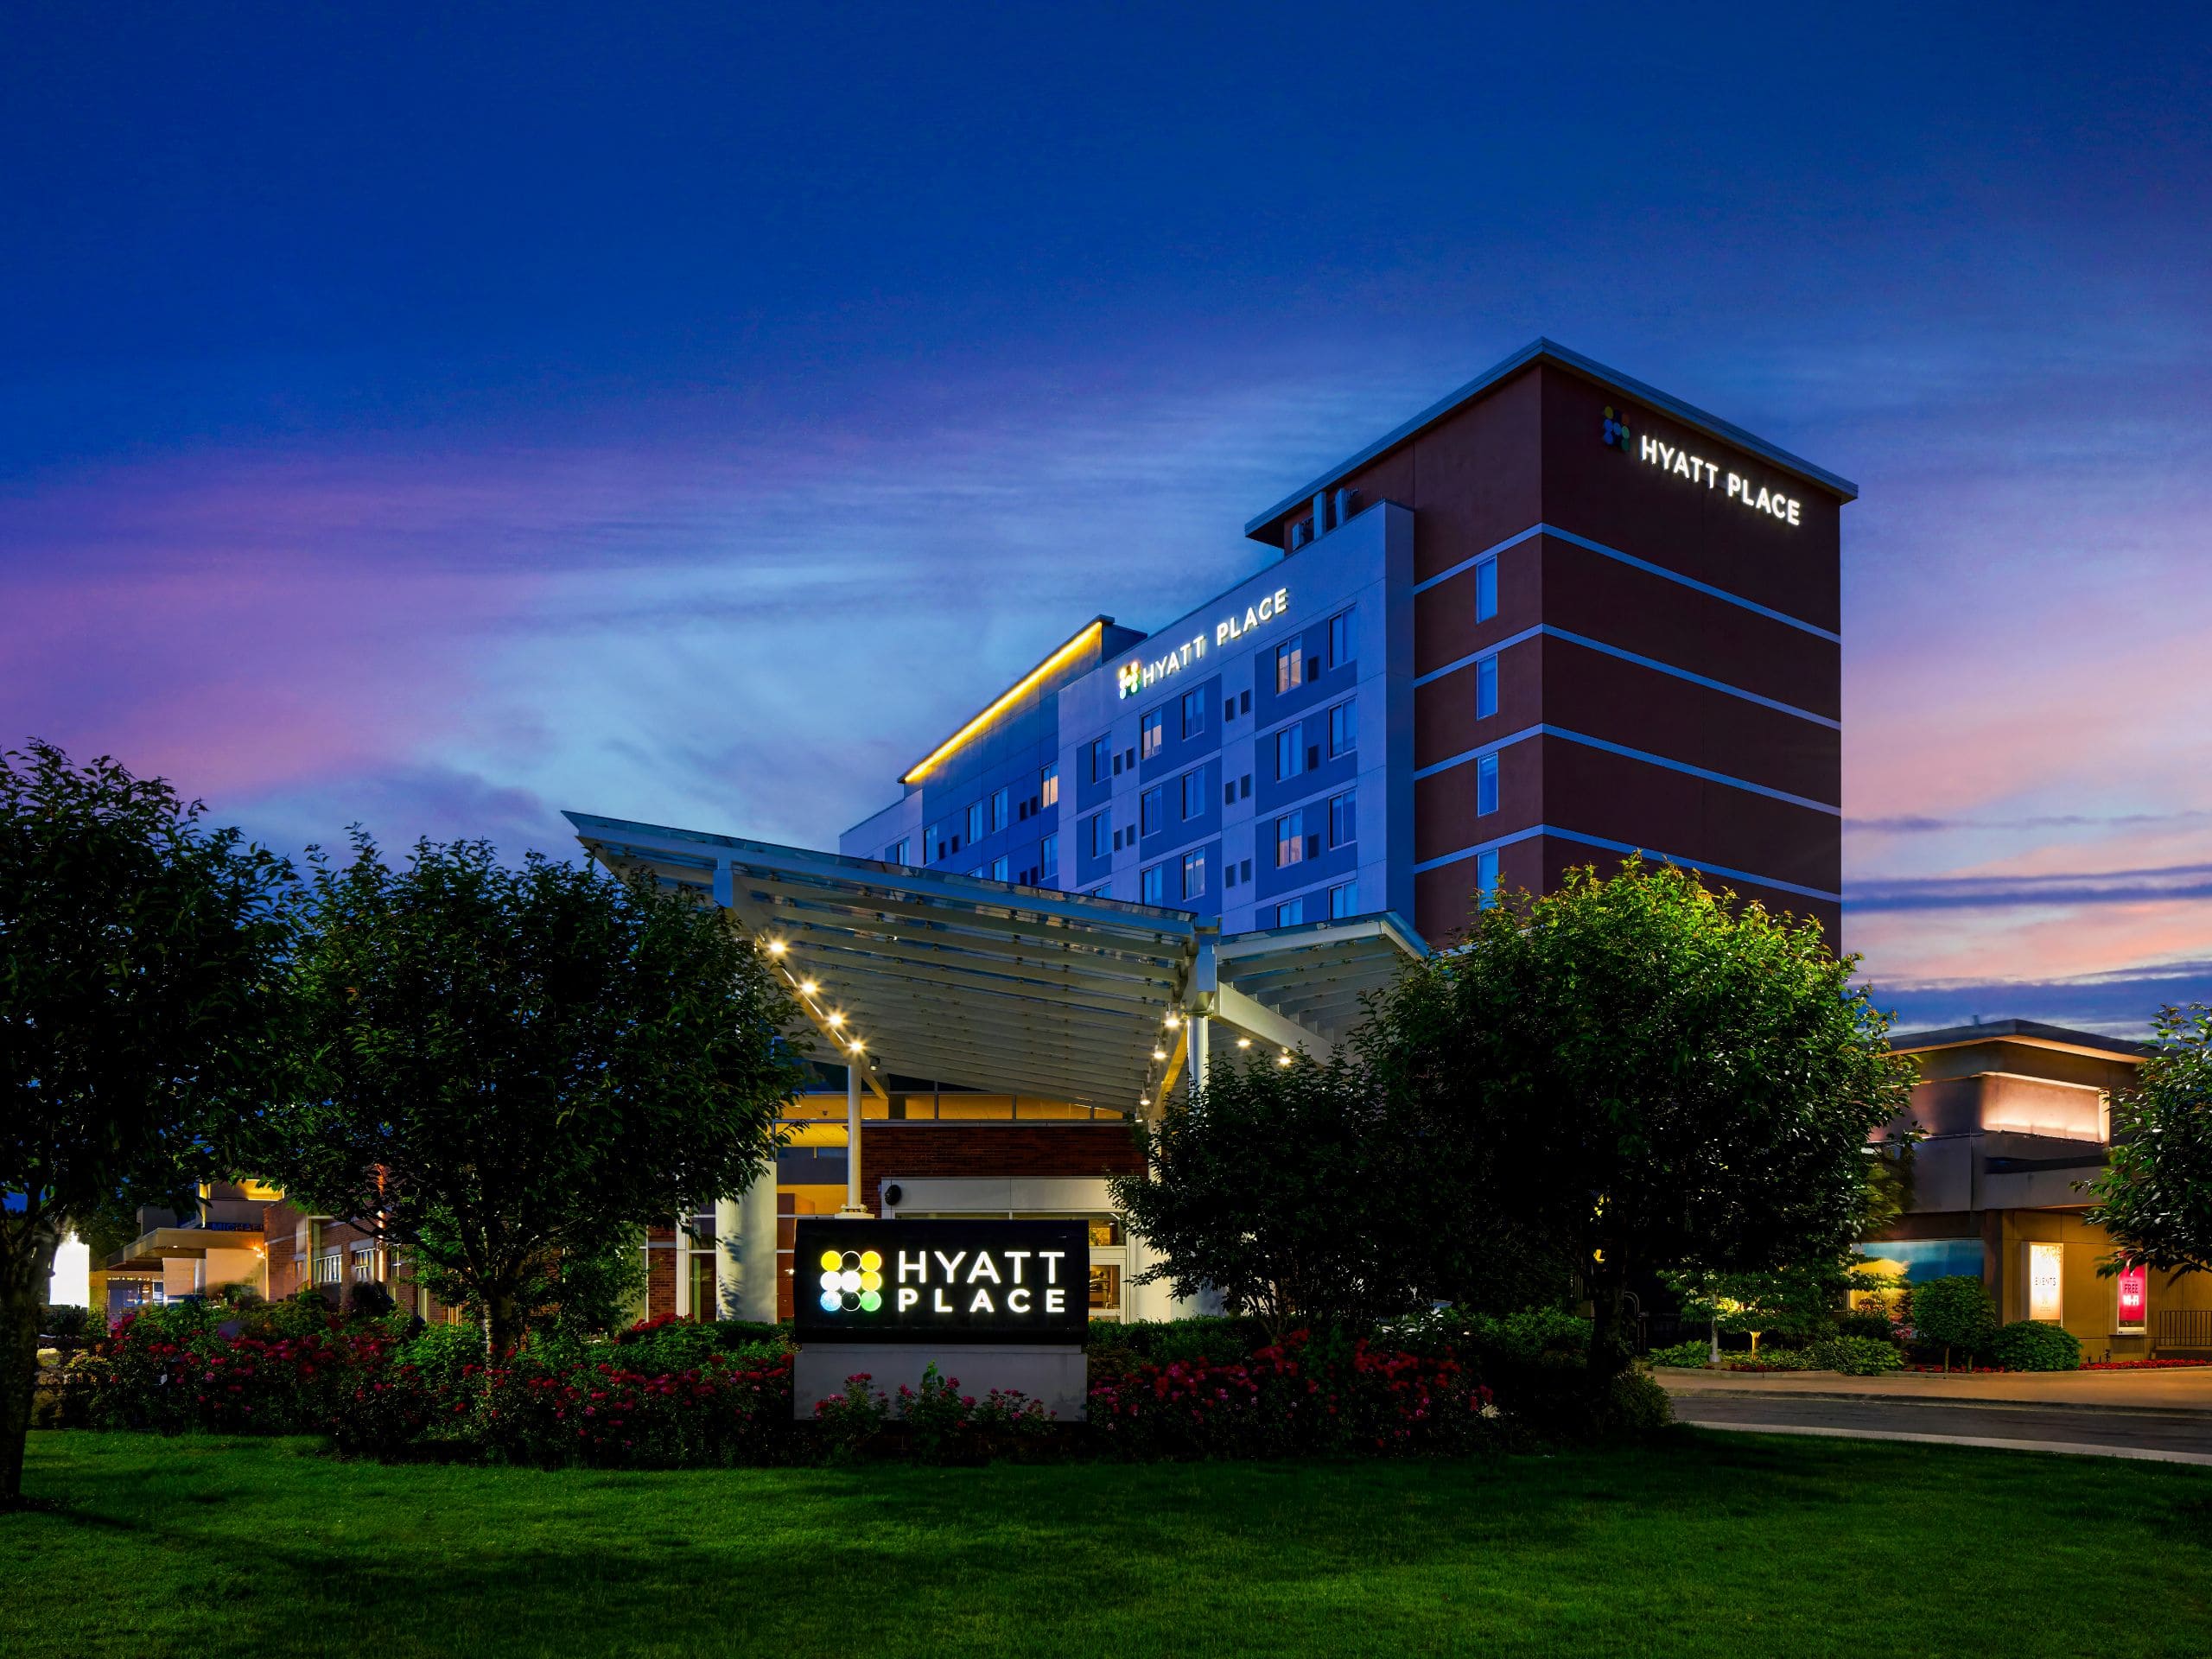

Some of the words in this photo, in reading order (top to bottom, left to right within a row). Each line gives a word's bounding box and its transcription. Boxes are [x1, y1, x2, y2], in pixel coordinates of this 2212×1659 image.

[1642, 435, 1719, 488] HYATT
[1728, 473, 1800, 525] PLACE
[1142, 635, 1205, 687] HYATT
[1217, 588, 1286, 645] PLACE
[899, 1251, 1065, 1283] HYATT
[899, 1288, 1065, 1313] PLACE
[2124, 1283, 2139, 1294] FREE
